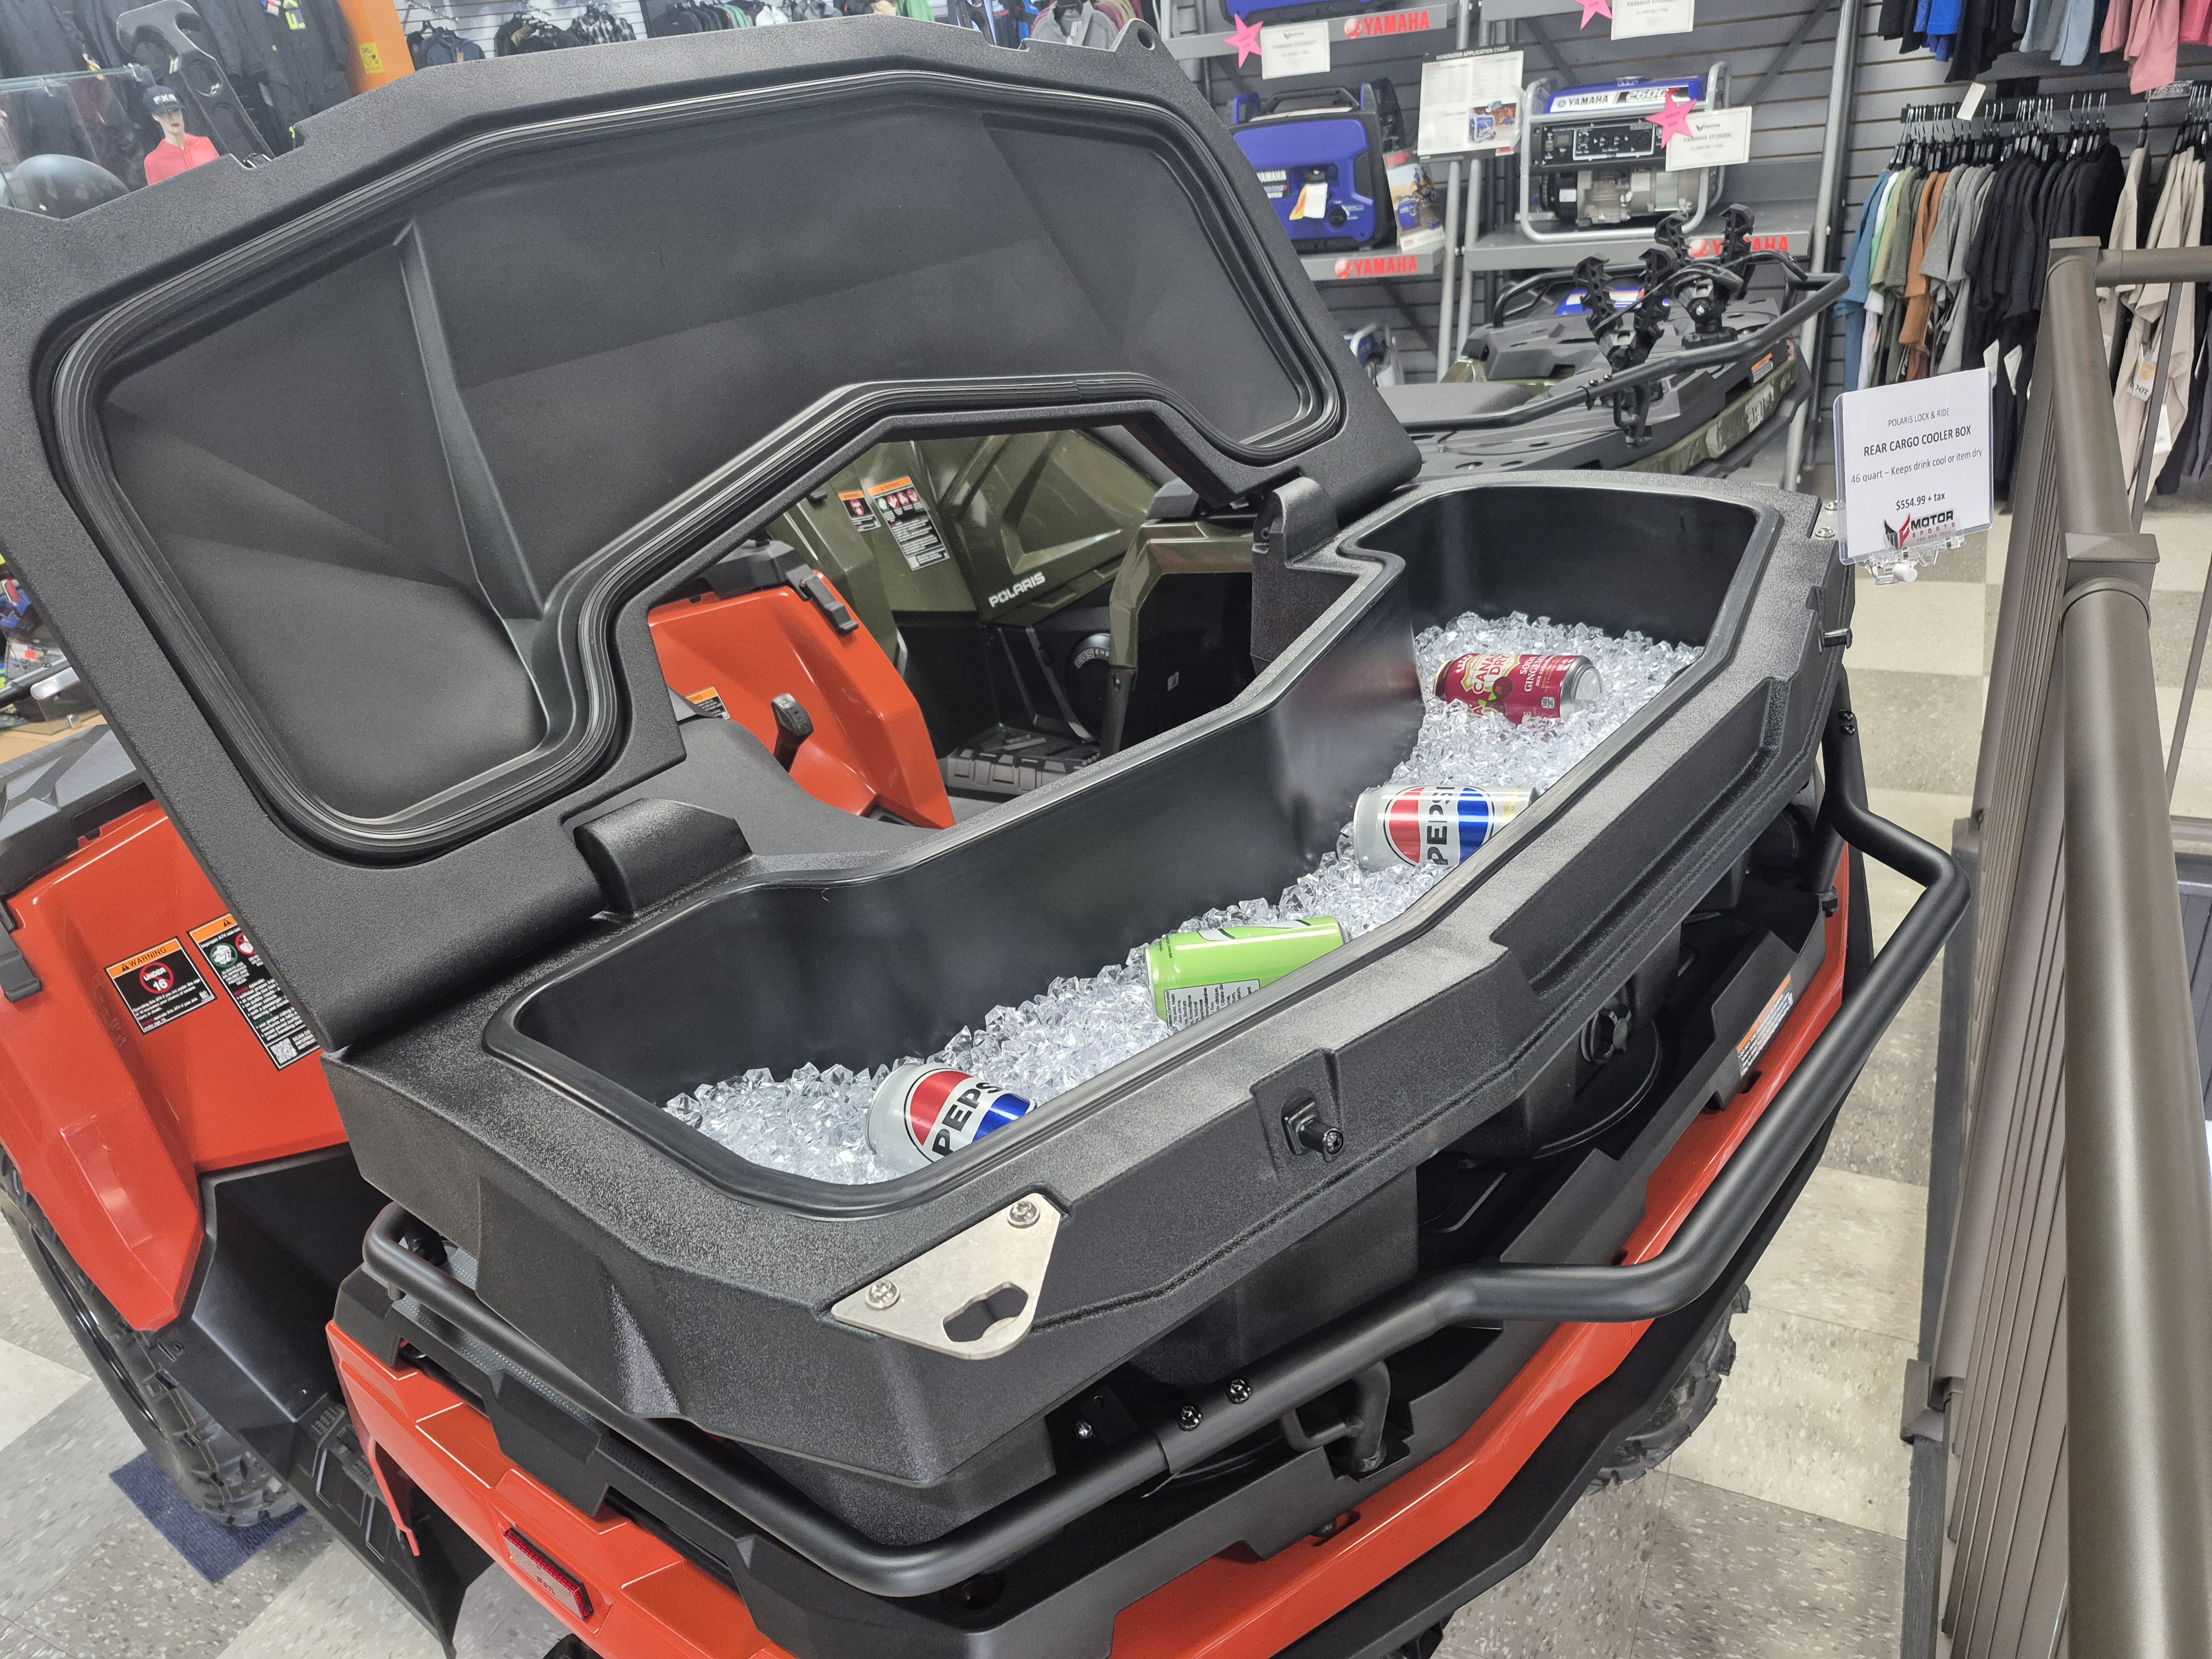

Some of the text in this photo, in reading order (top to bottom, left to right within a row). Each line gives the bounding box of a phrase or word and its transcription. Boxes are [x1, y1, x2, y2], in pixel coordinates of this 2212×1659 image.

[1364, 10, 1431, 36] YAMAHA
[1569, 95, 1609, 107] YAMAHA
[1712, 236, 1789, 256] YAHA
[1354, 254, 1419, 276] YAMAHA
[1888, 415, 1913, 427] POLARIS
[1914, 412, 1929, 422] LOCK
[1937, 408, 1949, 418] RIDE
[1864, 425, 1971, 457] REAR CARGO COOLER BOX
[1851, 474, 1861, 483] 46
[1863, 470, 1883, 483] quart
[1891, 465, 1912, 475] Keeps
[1913, 458, 1931, 471] drink
[1932, 455, 1946, 467] cool
[1957, 452, 1971, 461] item
[1972, 448, 1983, 458] dry
[1896, 495, 1926, 512] $554.99
[1934, 492, 1945, 502] tax
[1911, 510, 1954, 530] MOTOR
[1912, 521, 1955, 538] SPORTS
[988, 571, 1046, 608] POLARIS
[1490, 653, 1510, 676] DRY
[1519, 655, 1538, 675] SODA
[1426, 786, 1457, 865] PEPSI
[129, 948, 166, 967] WARNING
[143, 966, 166, 981] UNDER
[153, 978, 169, 993] 16
[932, 1082, 1003, 1156] PEPS
